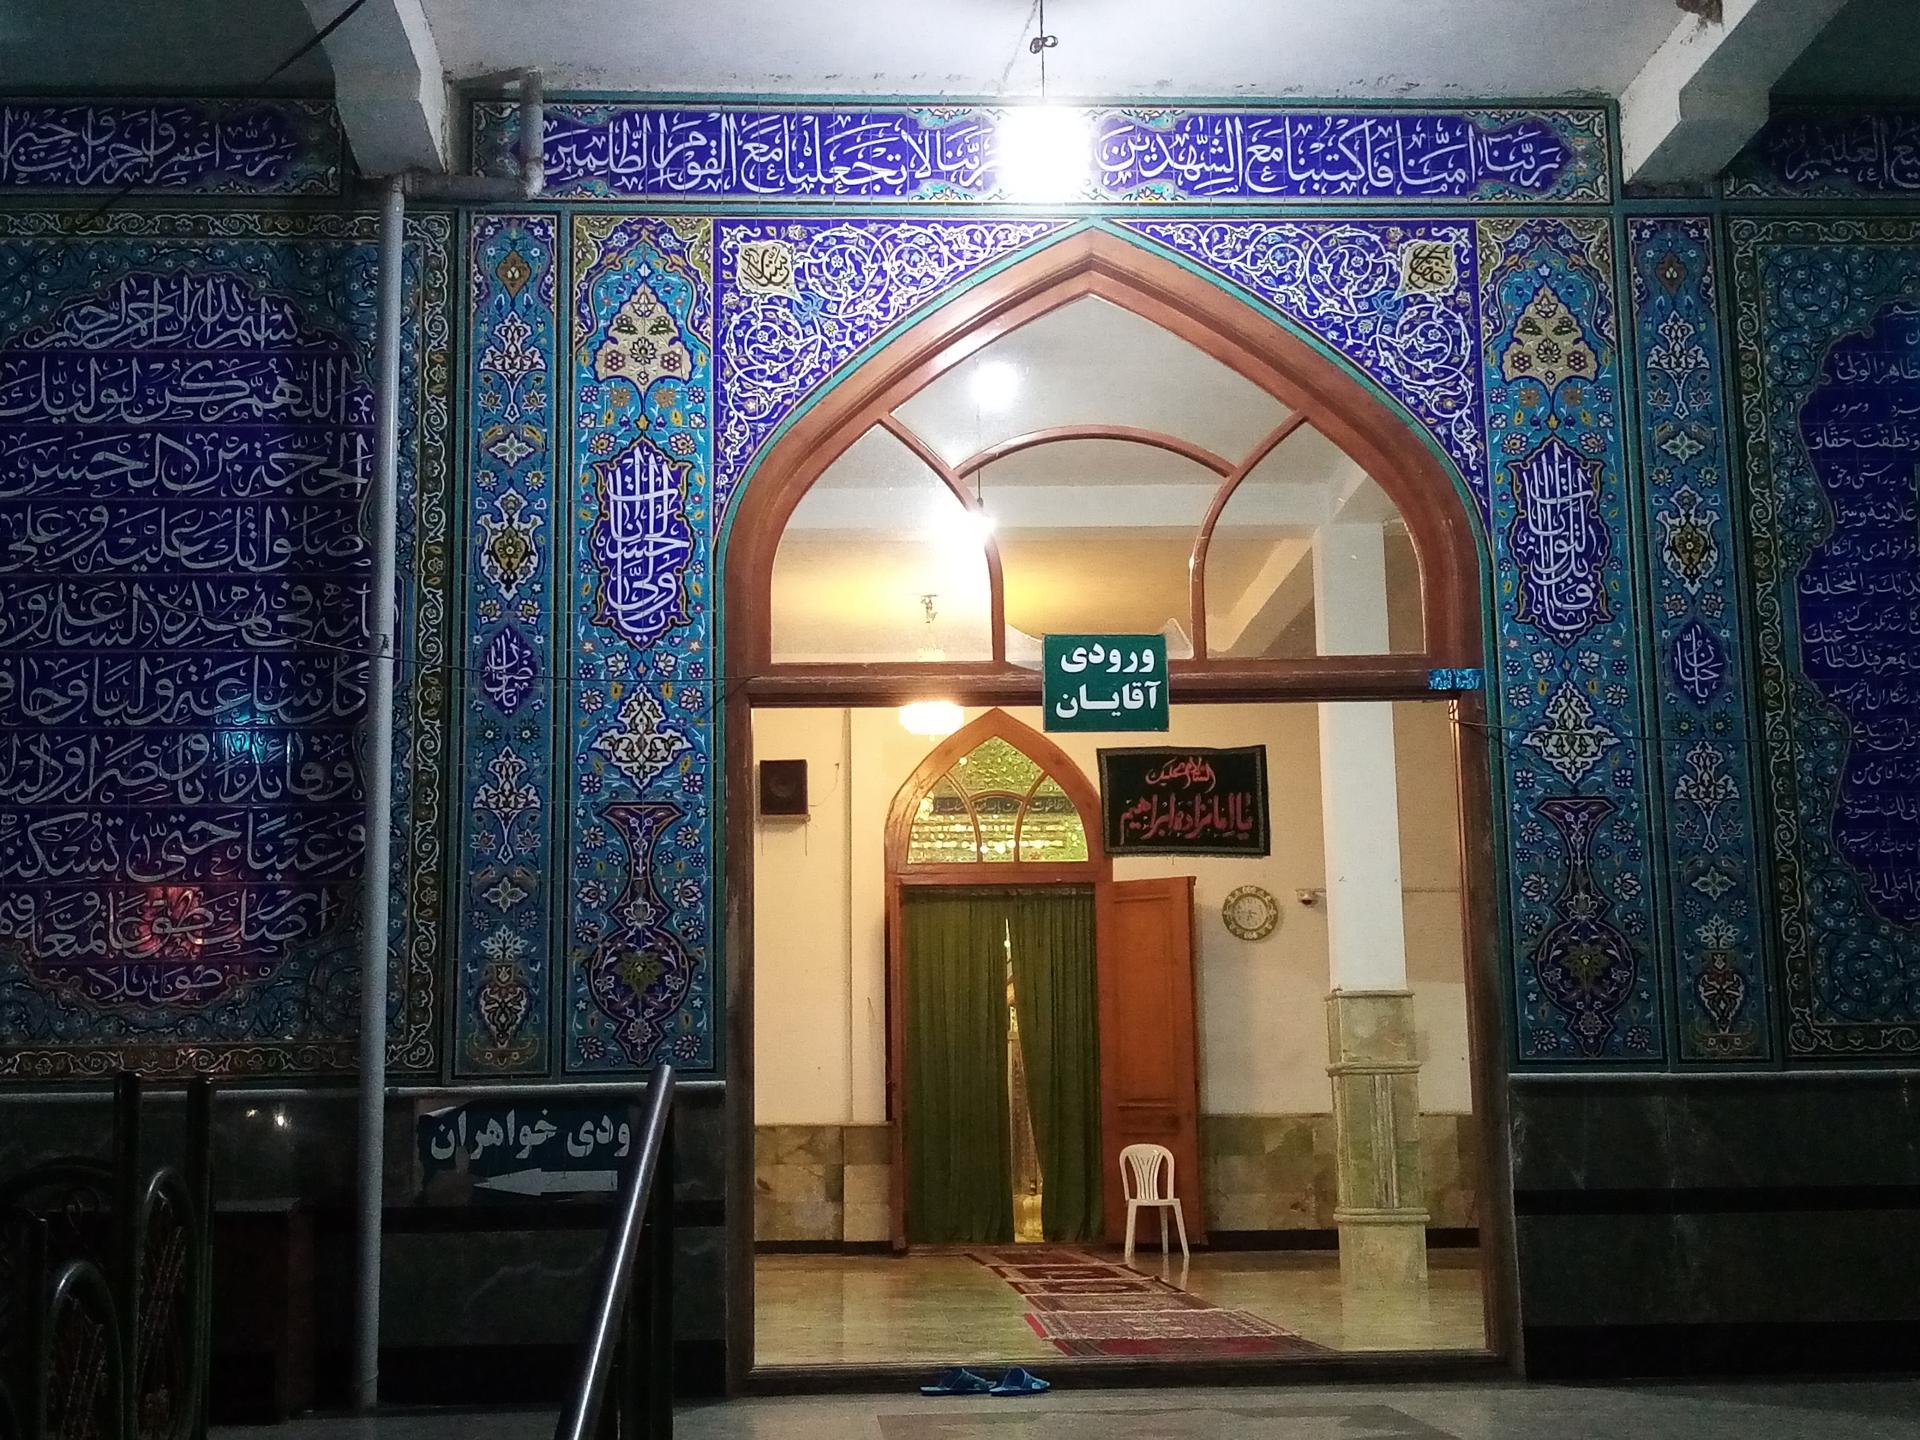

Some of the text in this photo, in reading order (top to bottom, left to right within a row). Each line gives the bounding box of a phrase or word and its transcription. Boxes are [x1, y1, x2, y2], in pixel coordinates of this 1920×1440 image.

[1060, 643, 1155, 673] ورودی
[1056, 680, 1161, 718] آقایان
[430, 1107, 558, 1160] خواهران
